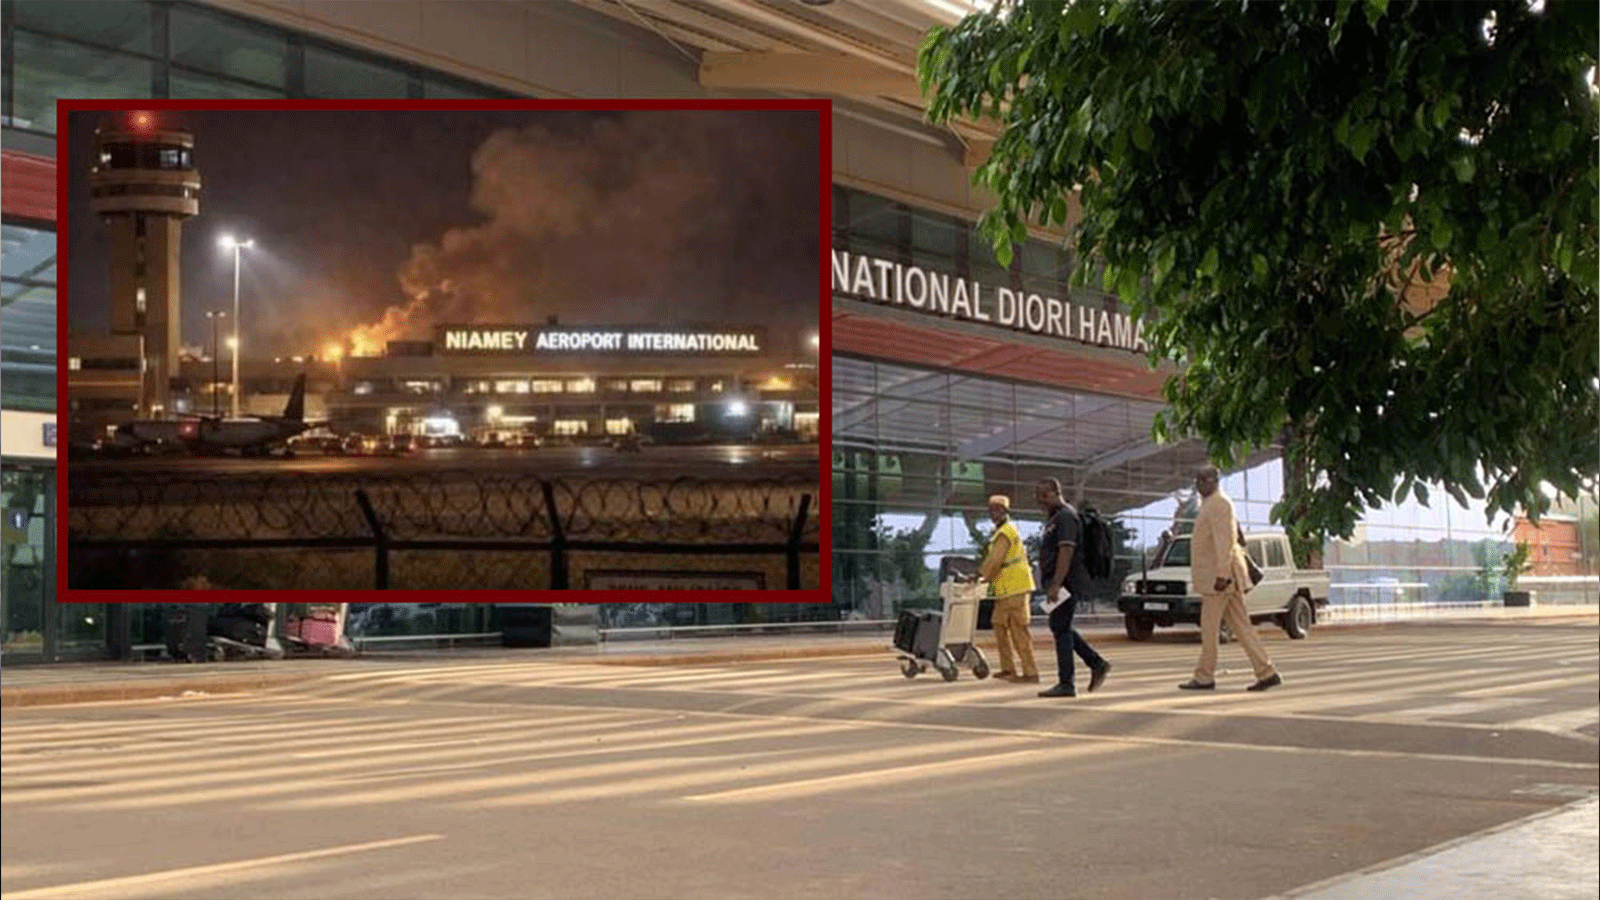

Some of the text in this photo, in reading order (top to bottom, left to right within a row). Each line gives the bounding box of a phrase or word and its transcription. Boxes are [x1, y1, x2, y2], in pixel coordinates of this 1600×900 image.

[832, 249, 1158, 352] NATIONAL DIORI HAMA
[445, 331, 759, 351] NIAMEY AEROPORT INTERNATIONAL
